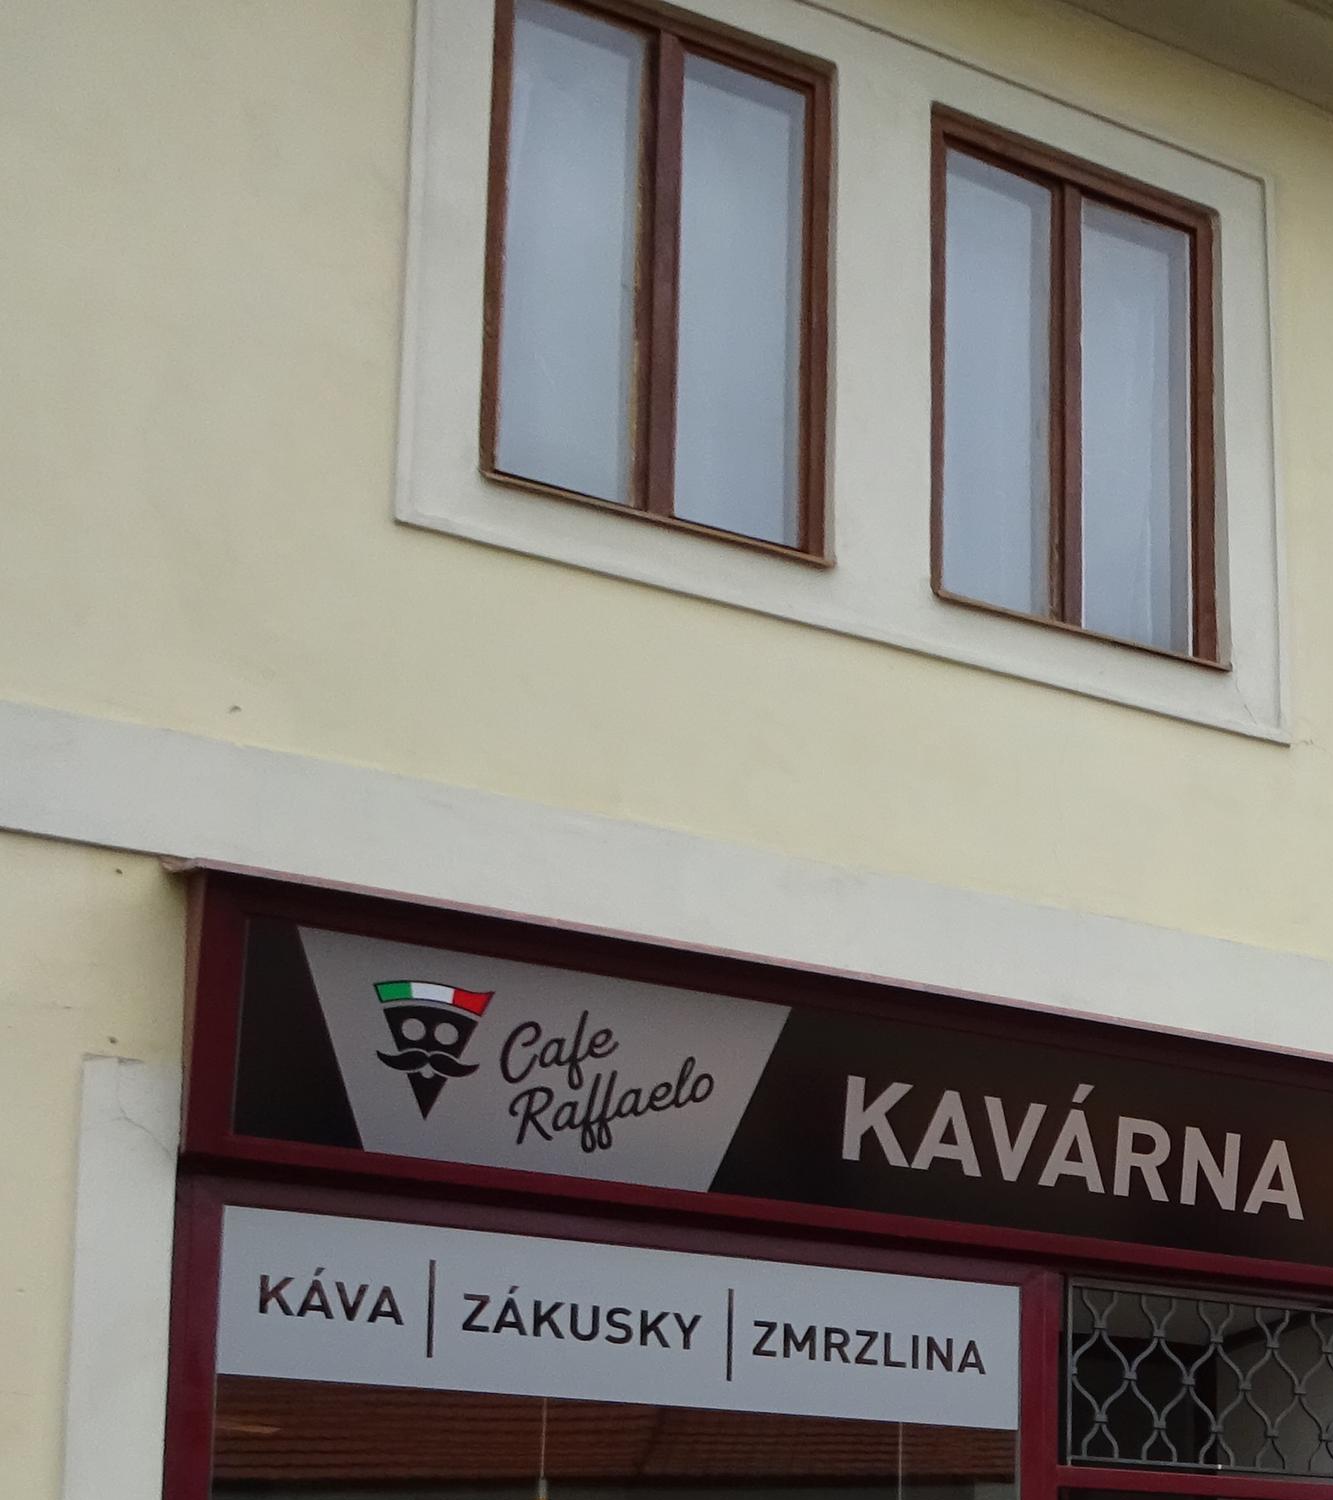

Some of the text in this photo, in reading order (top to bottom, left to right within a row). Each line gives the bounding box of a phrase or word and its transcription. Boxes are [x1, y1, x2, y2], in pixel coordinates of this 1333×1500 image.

[500, 1010, 619, 1090] Cafe
[508, 1056, 714, 1153] Raffaelo
[841, 1075, 1304, 1220] KAVÁRNA
[258, 1267, 987, 1376] KÁVA ZÁKUSKY ZMRZLINA
